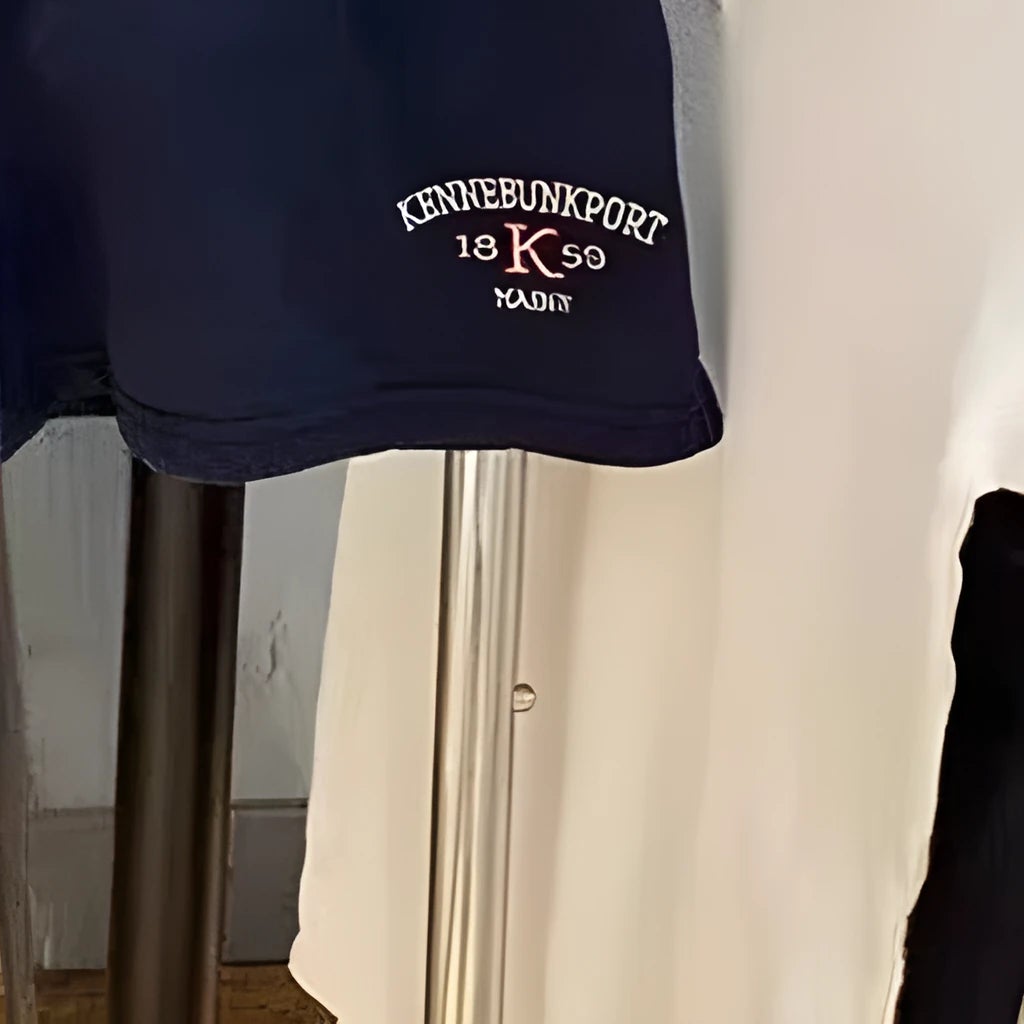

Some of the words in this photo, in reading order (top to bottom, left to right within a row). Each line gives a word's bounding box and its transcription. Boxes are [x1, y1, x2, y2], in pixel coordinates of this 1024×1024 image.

[396, 177, 669, 246] KENNEBUNKPORT
[455, 234, 499, 261] 18
[503, 222, 566, 279] K
